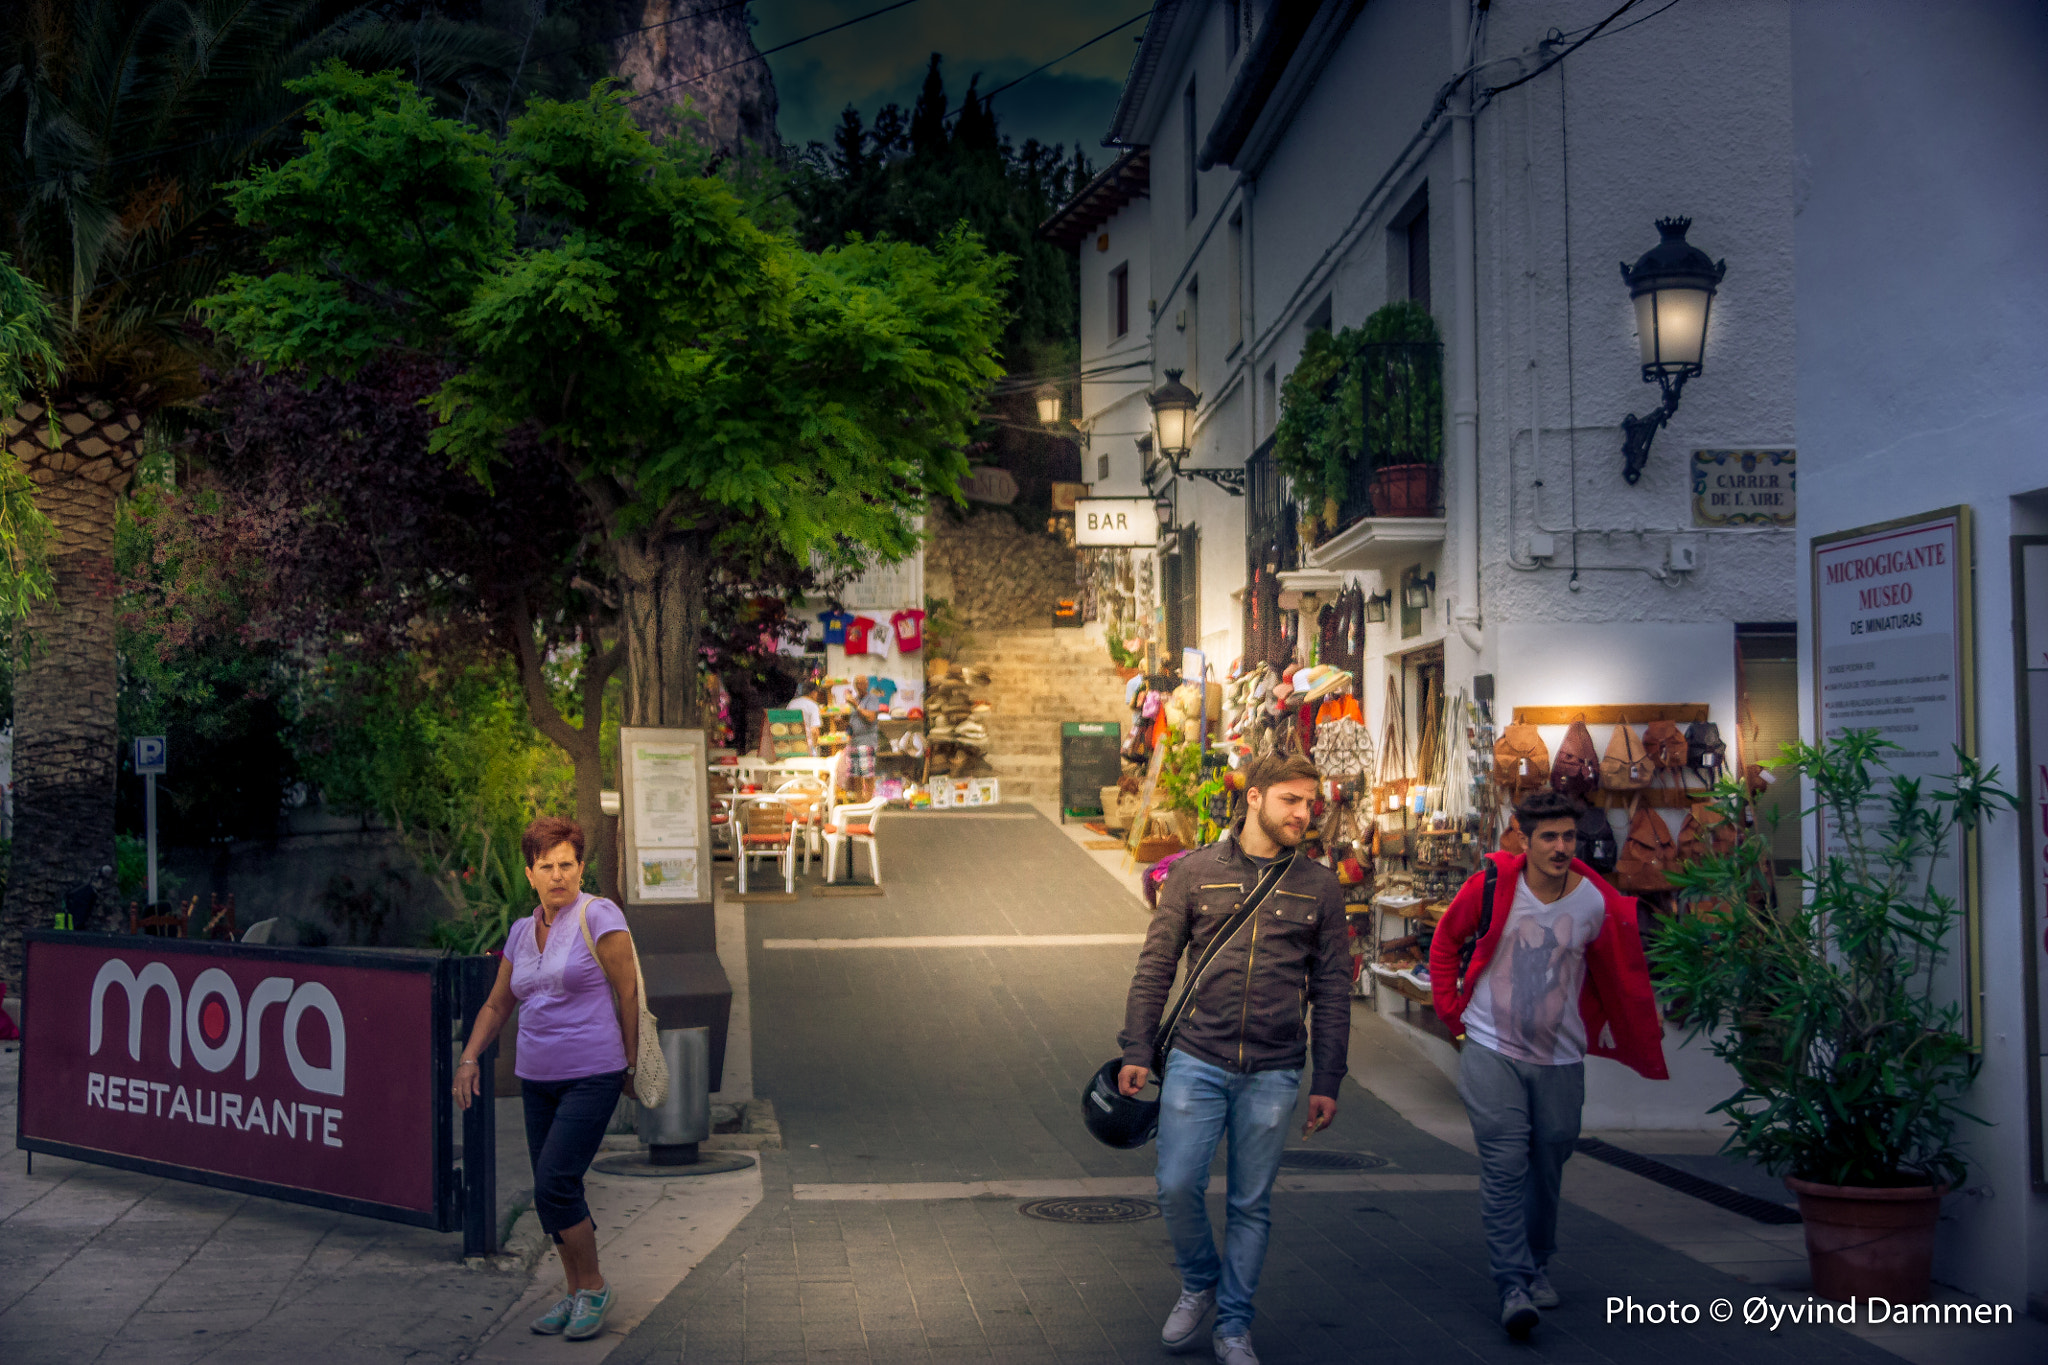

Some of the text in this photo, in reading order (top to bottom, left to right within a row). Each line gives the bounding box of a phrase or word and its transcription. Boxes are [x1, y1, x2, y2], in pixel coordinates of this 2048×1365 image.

[1716, 474, 1780, 489] CARRER
[1711, 492, 1731, 506] DE
[1087, 512, 1128, 531] BAR
[1826, 543, 1945, 585] MICROGIGANTE
[1859, 582, 1913, 611] MUSEO
[1850, 612, 1923, 635] DE MINIATURAS
[140, 740, 162, 763] P
[89, 958, 347, 1097] mora
[87, 1072, 344, 1148] RESTAURANTE
